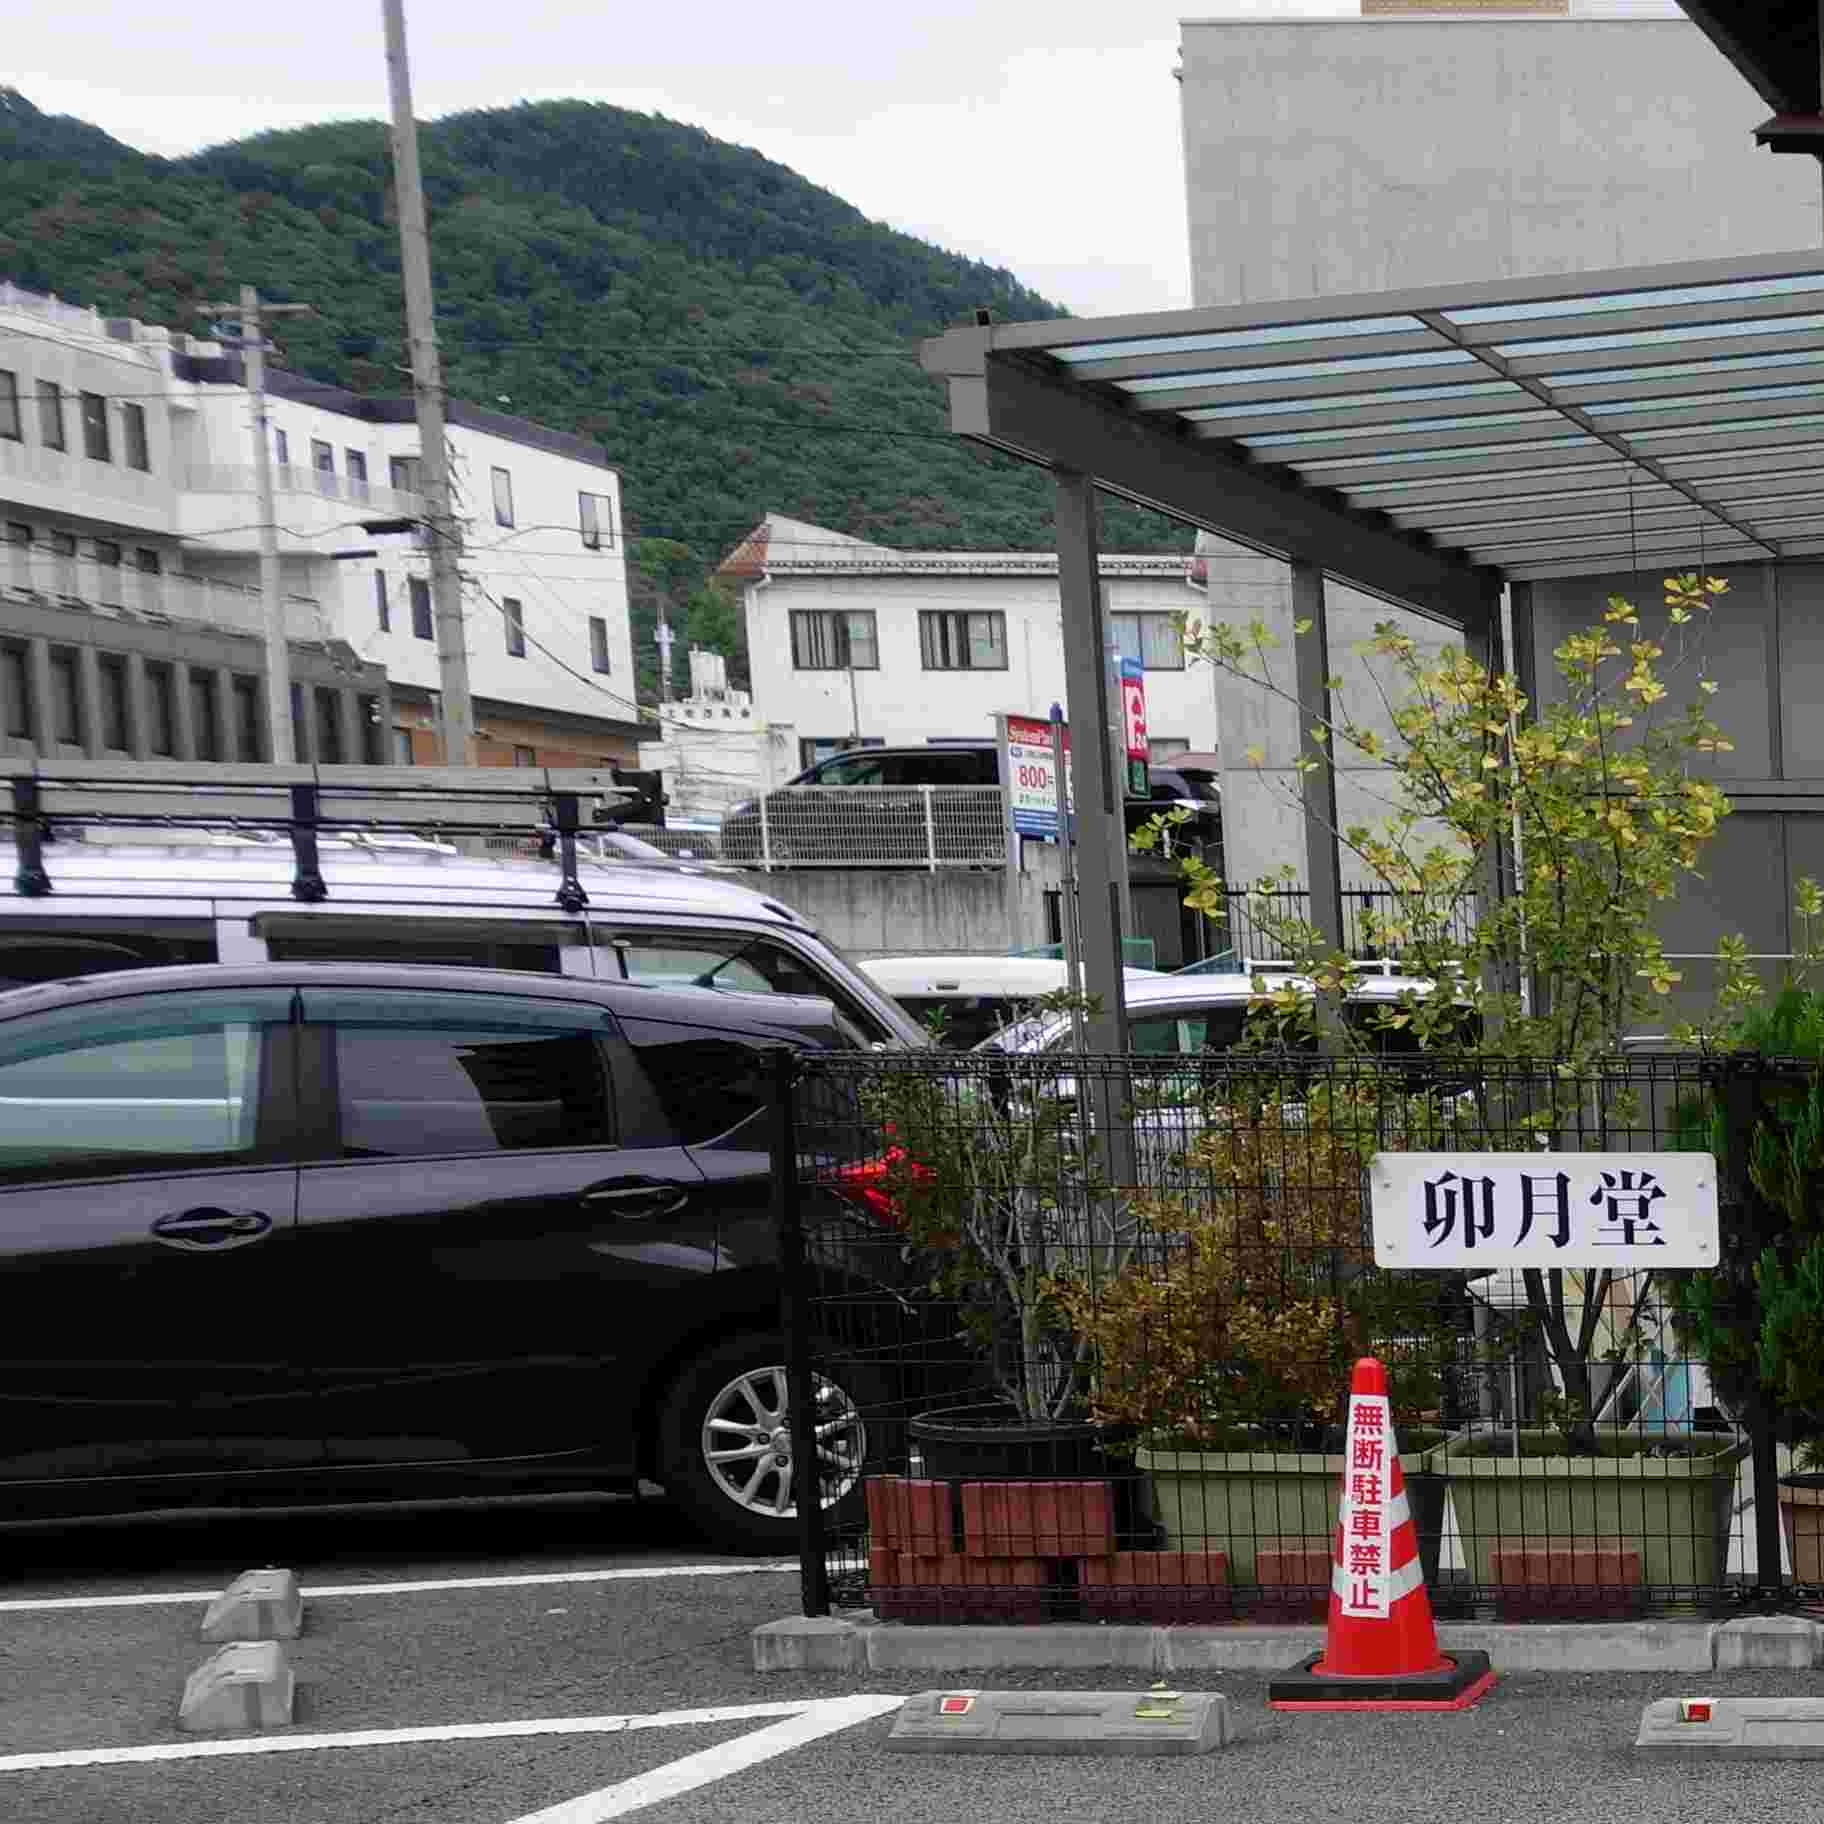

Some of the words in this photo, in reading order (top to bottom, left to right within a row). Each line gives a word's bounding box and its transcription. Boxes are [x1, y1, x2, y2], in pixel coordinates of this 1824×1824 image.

[1423, 1170, 1667, 1249] 卯月堂
[1349, 1402, 1386, 1612] 無断駐車禁止
